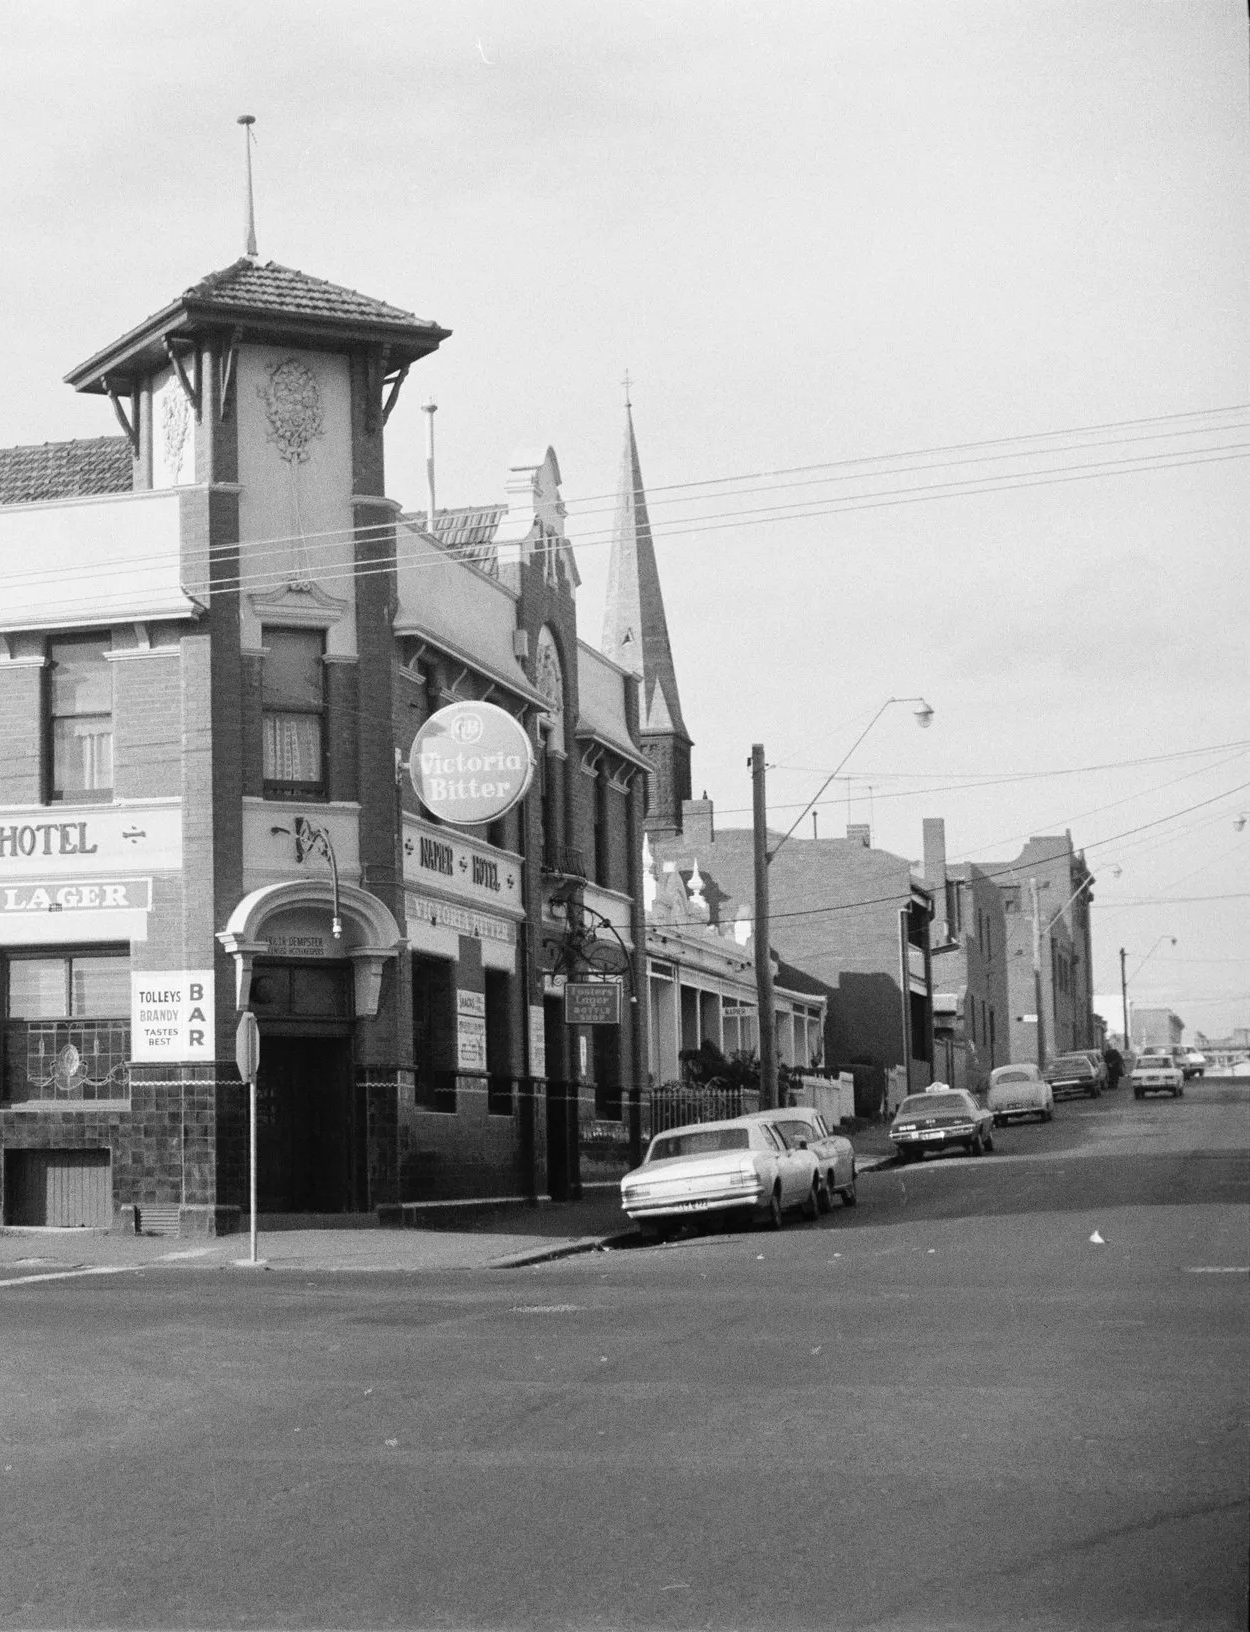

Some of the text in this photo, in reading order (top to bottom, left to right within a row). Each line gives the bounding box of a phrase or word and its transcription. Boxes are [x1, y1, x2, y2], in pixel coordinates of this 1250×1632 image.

[421, 751, 522, 774] Victoria
[430, 778, 510, 801] Bitter
[420, 837, 501, 892] NAPIER HOTEL
[4, 884, 130, 909] LAGER
[139, 991, 181, 1003] TOLLEYS
[140, 1010, 179, 1022] BRANDY
[188, 983, 206, 1046] BAR
[144, 1028, 179, 1036] TASTES
[149, 1038, 171, 1046] BEST
